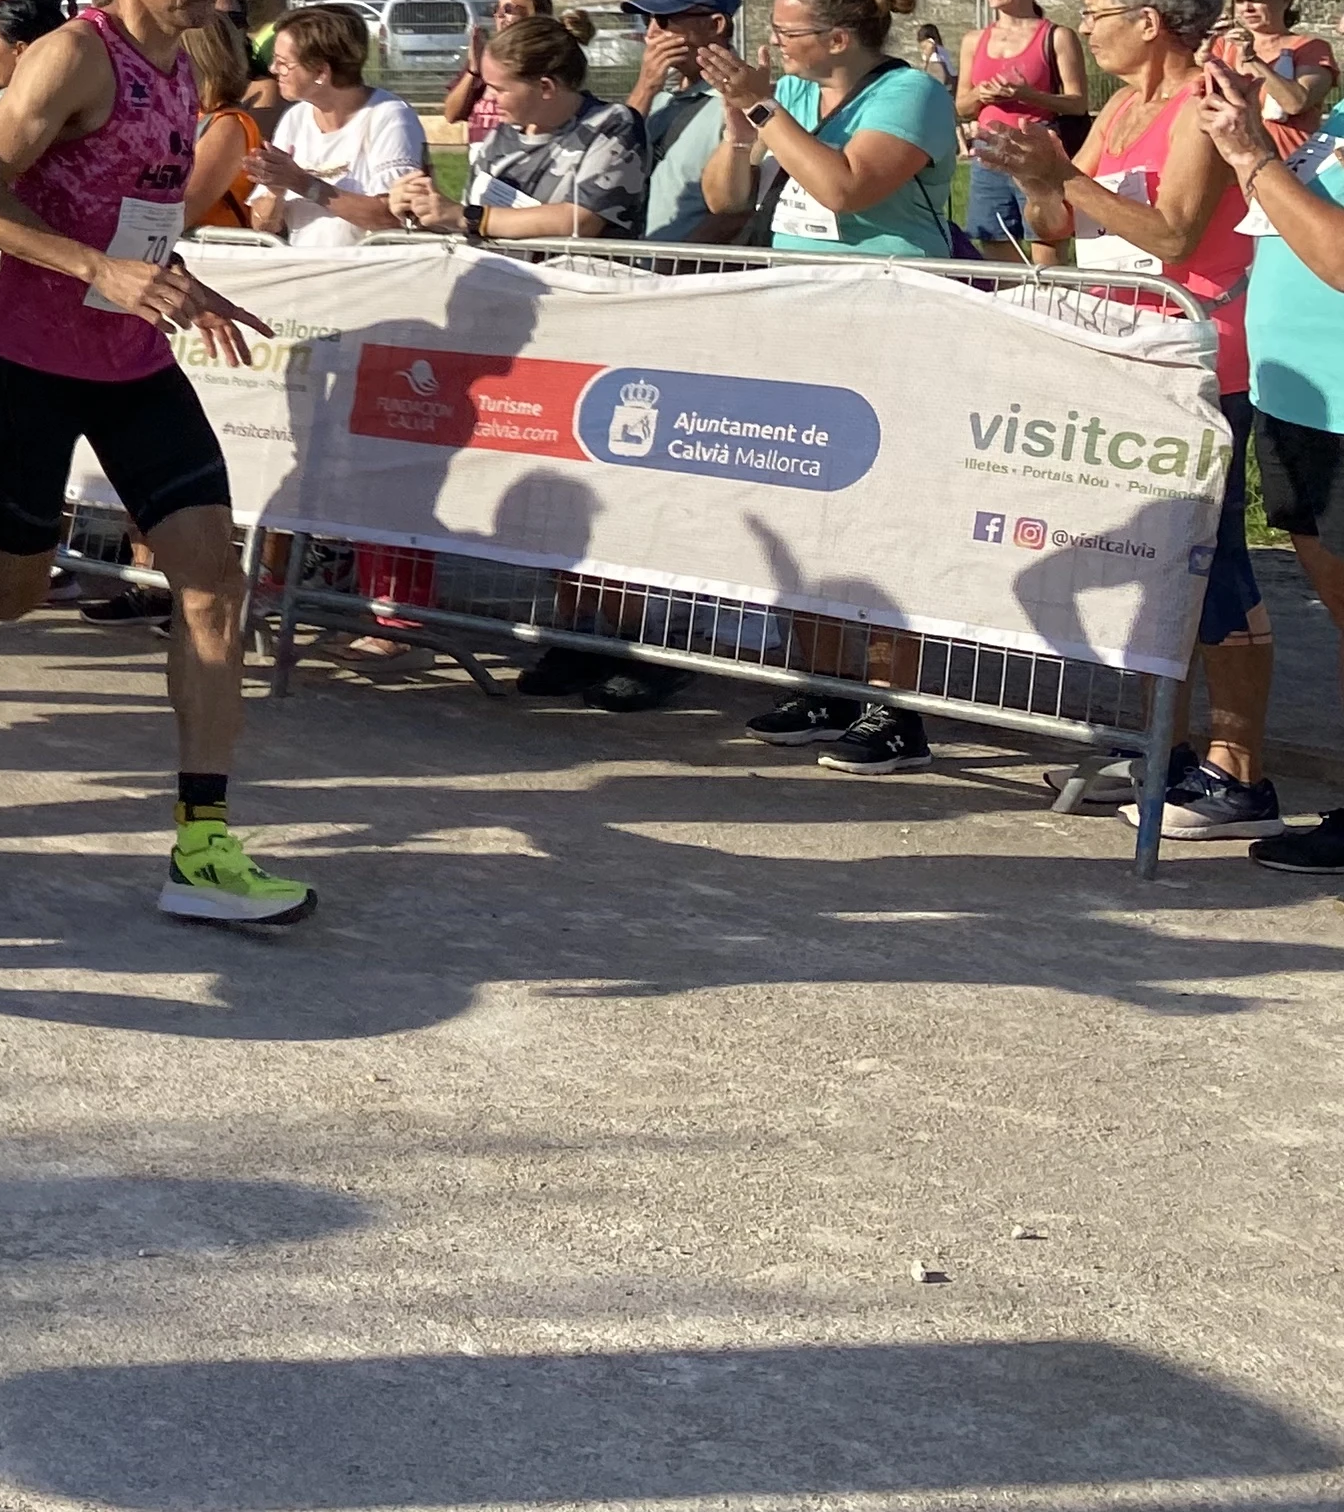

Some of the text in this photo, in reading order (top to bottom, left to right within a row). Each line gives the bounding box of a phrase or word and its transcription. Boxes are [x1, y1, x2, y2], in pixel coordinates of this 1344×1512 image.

[477, 395, 544, 417] Turisme
[673, 411, 830, 447] Ajuntament de
[667, 439, 821, 477] Calvià Mallorca
[1078, 473, 1110, 489] Nou
[1051, 529, 1157, 560] @visitcalvia
